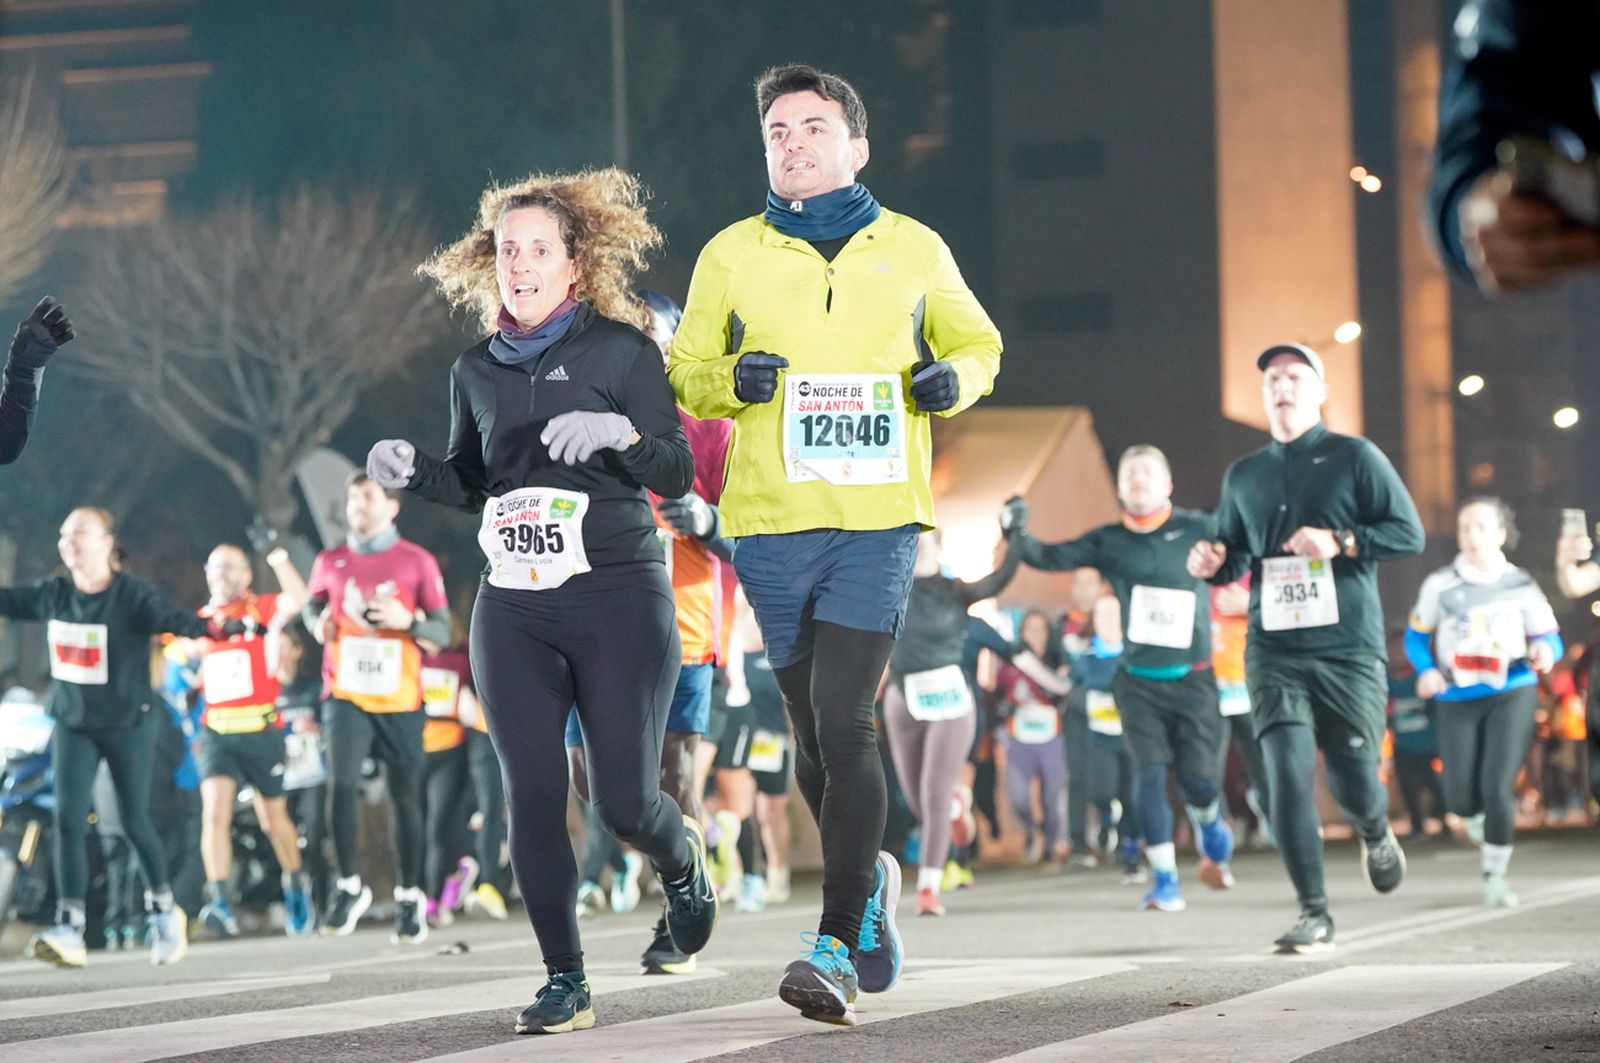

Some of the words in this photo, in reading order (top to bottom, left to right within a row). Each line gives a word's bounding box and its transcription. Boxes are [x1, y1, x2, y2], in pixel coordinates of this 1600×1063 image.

[545, 373, 569, 381] adidas
[812, 387, 848, 397] NOCHE
[850, 387, 863, 397] DE
[798, 400, 821, 411] SAN
[824, 398, 864, 411] ANTÓN
[800, 414, 890, 447] 12046
[506, 499, 528, 513] OCHE
[528, 498, 541, 508] DE
[493, 516, 513, 528] SAN
[498, 523, 565, 555] 3965
